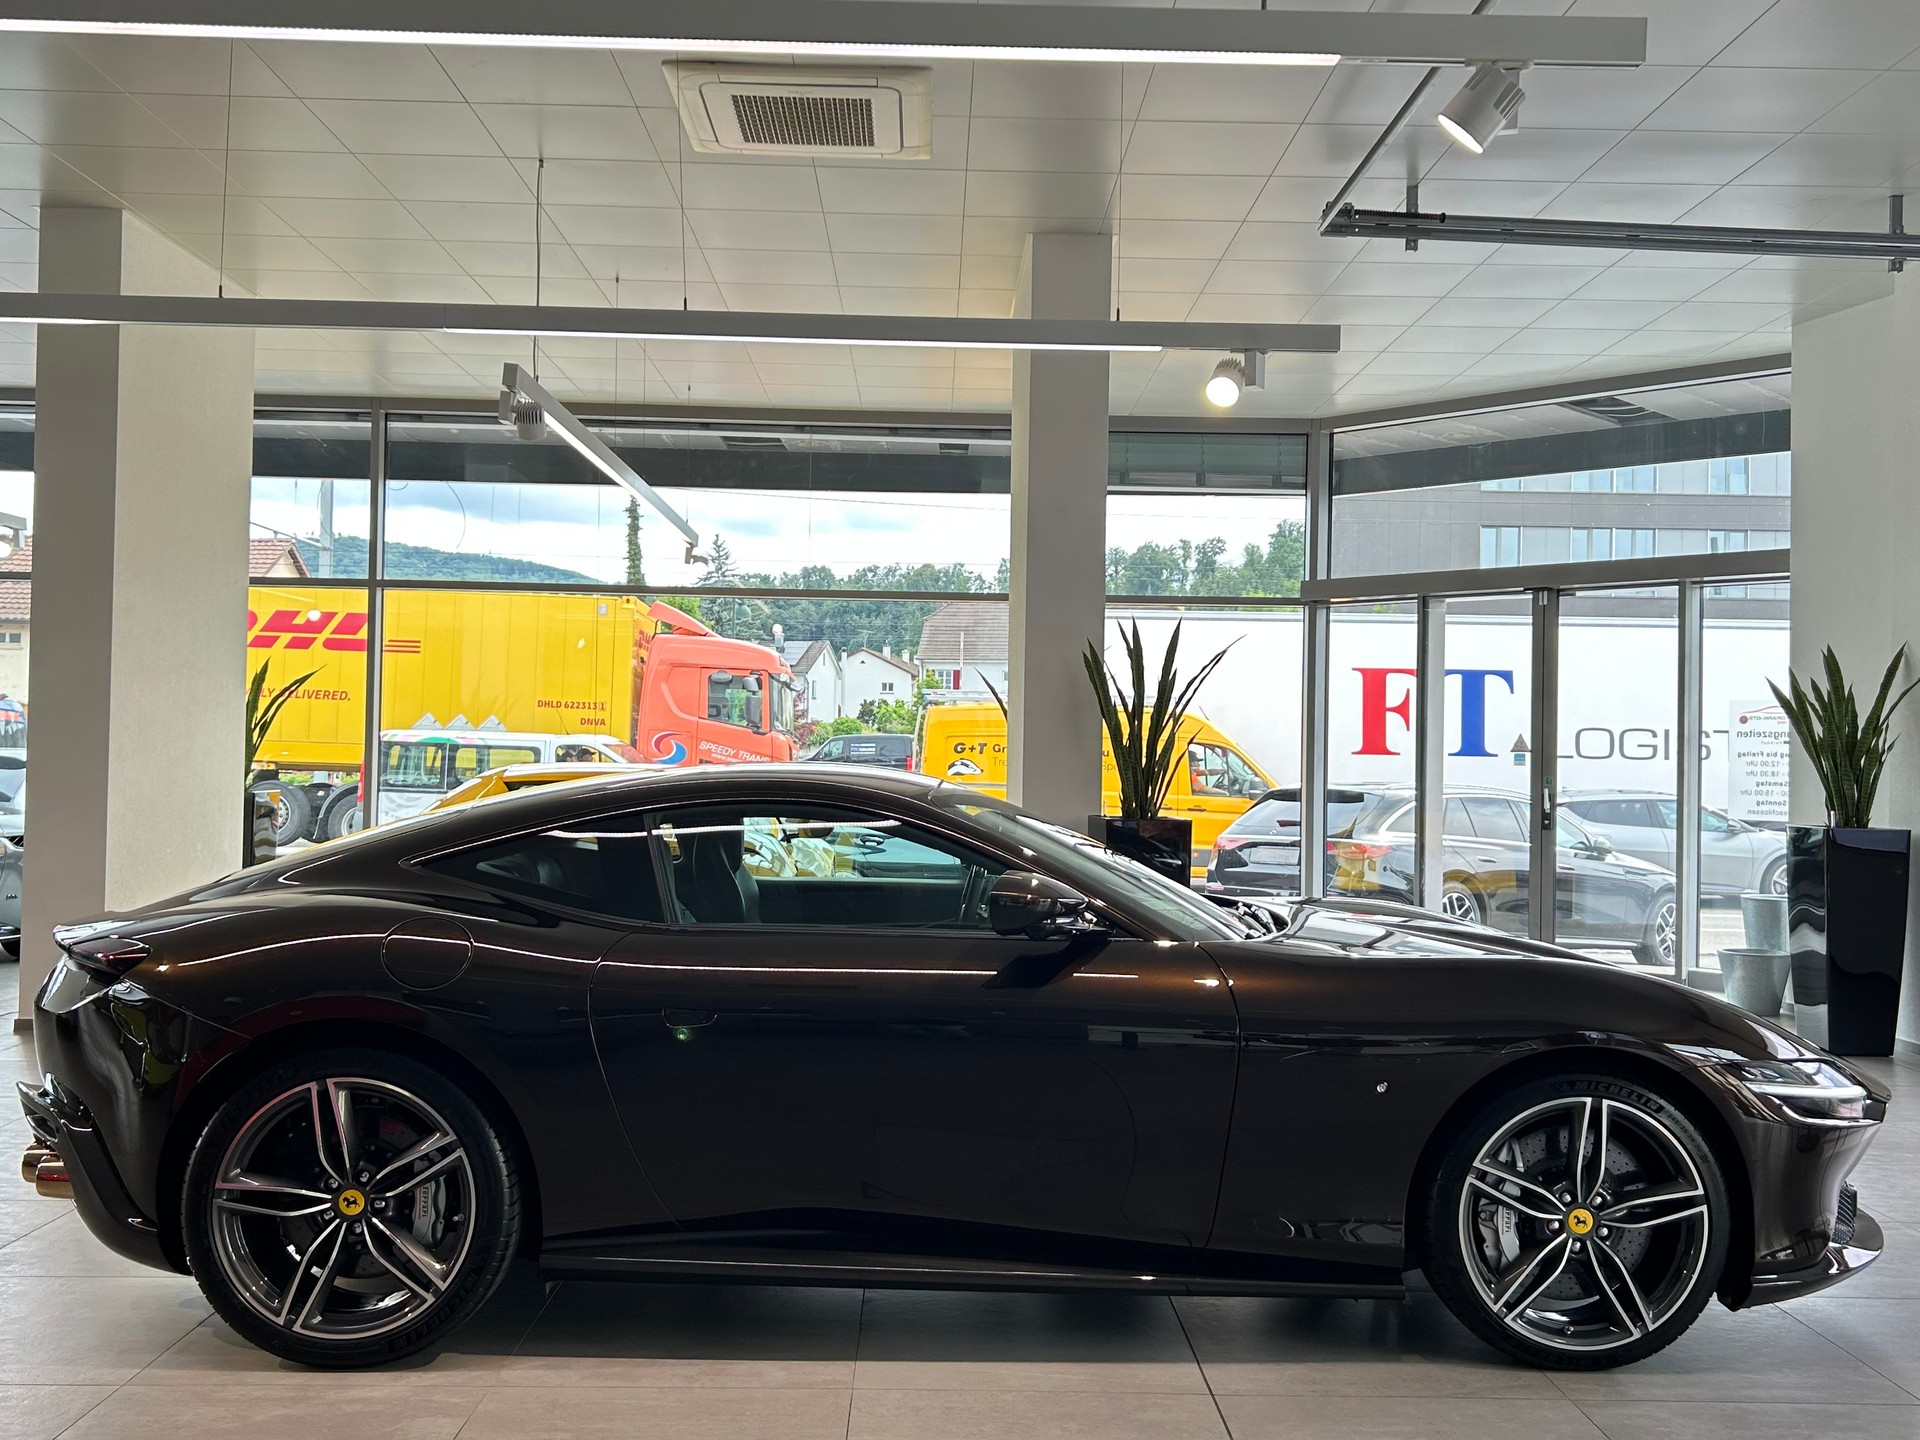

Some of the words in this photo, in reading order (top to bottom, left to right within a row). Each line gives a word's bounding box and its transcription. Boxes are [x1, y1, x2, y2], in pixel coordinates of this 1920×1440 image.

[247, 609, 369, 652] HL
[279, 687, 351, 702] LIVERED.
[537, 700, 562, 709] DHLD
[564, 701, 598, 710] 622313
[1351, 667, 1514, 757] FT
[580, 717, 606, 726] DNVA
[699, 740, 737, 757] SPEEDY
[953, 741, 988, 755] G+T
[1574, 1080, 1660, 1112] MICHELIN
